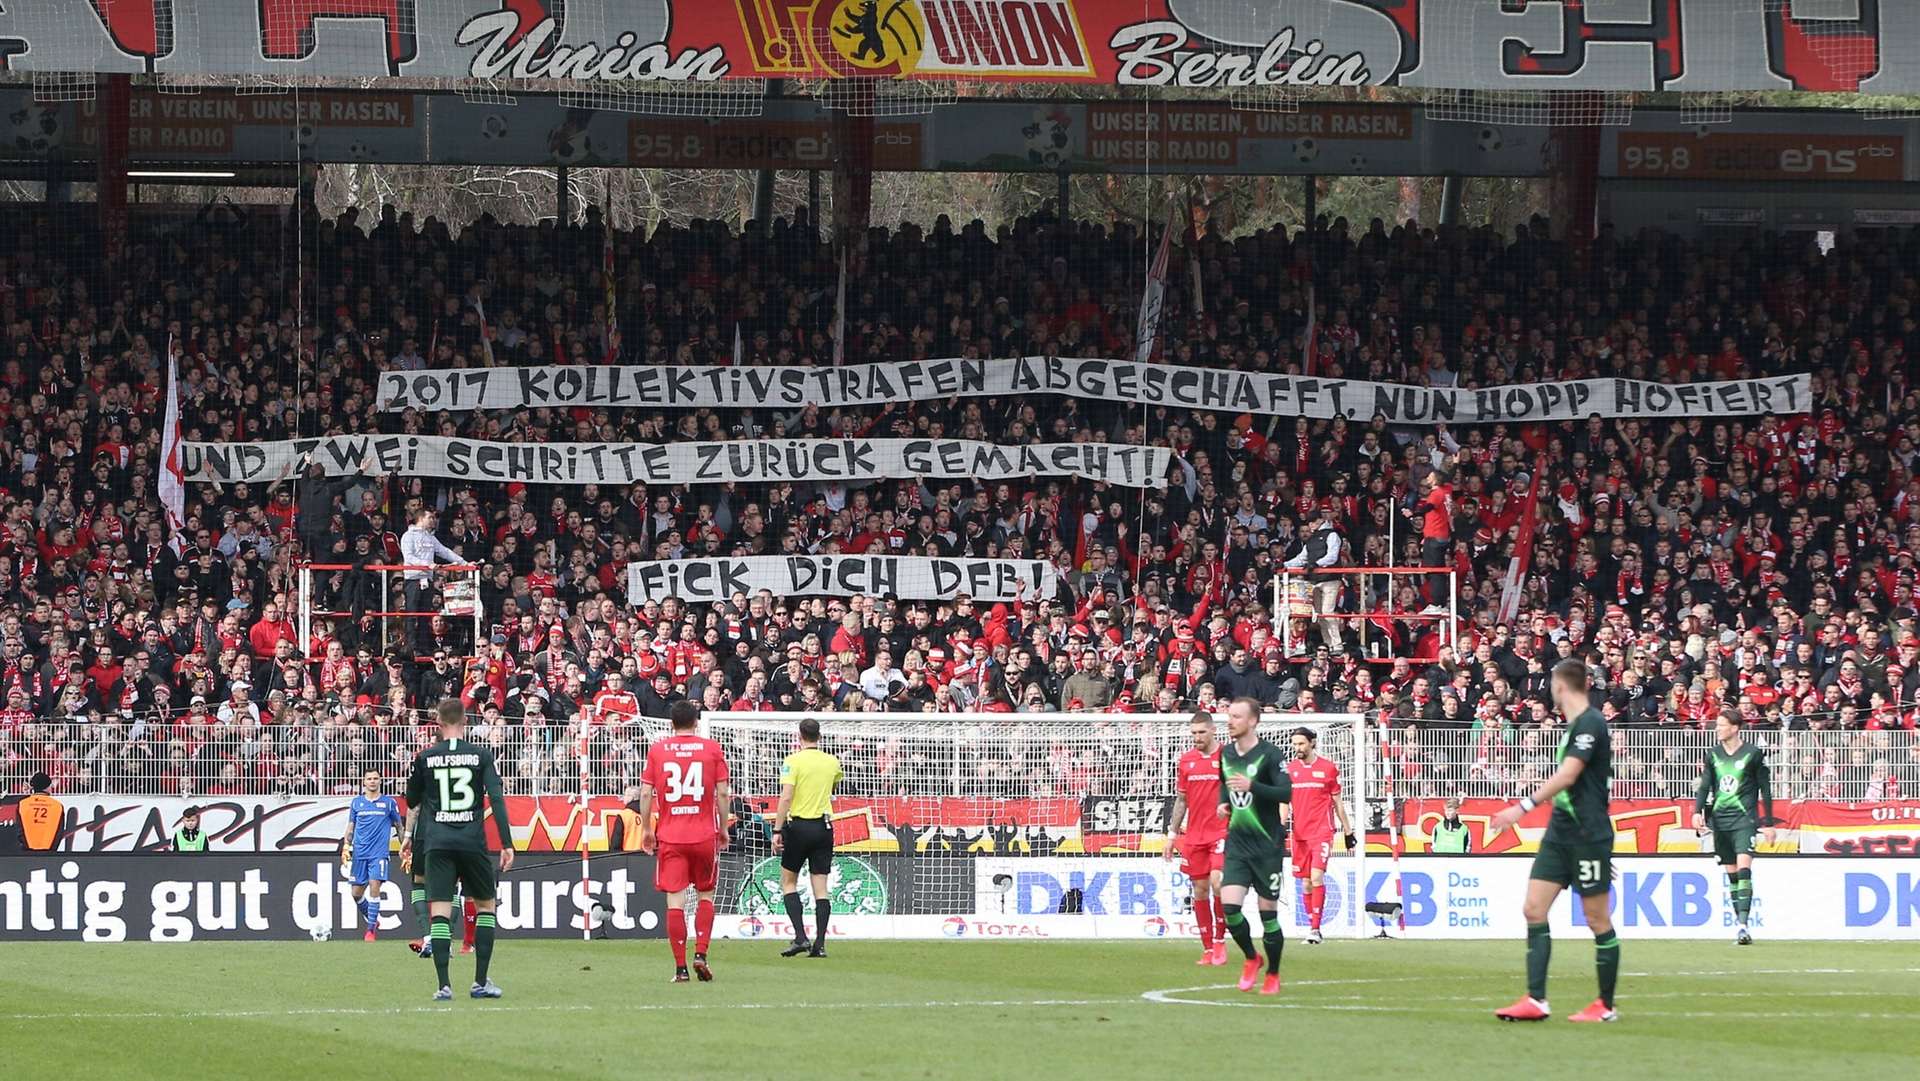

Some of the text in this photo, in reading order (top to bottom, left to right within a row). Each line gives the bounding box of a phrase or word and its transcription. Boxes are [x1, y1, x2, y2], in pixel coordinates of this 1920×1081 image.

[456, 10, 730, 79] Union
[918, 0, 1087, 67] UNION
[1110, 25, 1371, 86] Berlin
[83, 101, 406, 122] UER VEREIN, UNSER RASEN,
[1092, 112, 1405, 135] UNSER VEREIN, UNSER RASEN,
[83, 127, 225, 147] UER RADIO
[633, 134, 700, 160] 95,8
[1092, 140, 1231, 160] UNSER RADIO
[1624, 146, 1690, 173] 95,8
[1857, 143, 1895, 157] rbb
[386, 372, 489, 408] 2017
[1375, 385, 1457, 422] NUN
[1476, 381, 1590, 421] HOPP
[181, 440, 268, 480] UND
[696, 440, 876, 480] ZURÜCK
[903, 440, 1155, 486] GEMACHT!
[427, 754, 480, 768] WOLFSBURG
[433, 767, 475, 811] 13
[663, 761, 705, 803] 34
[33, 807, 48, 818] 72
[1321, 842, 1330, 857] 3
[379, 860, 385, 877] 1
[1578, 859, 1601, 882] 31
[1270, 872, 1283, 890] 2
[1448, 873, 1479, 888] Das
[150, 868, 270, 942] gut
[291, 862, 404, 930] die
[496, 868, 659, 931] urst.
[1017, 871, 1161, 916] DKB
[1295, 871, 1438, 927] DKB
[1448, 893, 1488, 907] kann
[972, 921, 1049, 936] TOTAL
[1448, 912, 1489, 927] Bank
